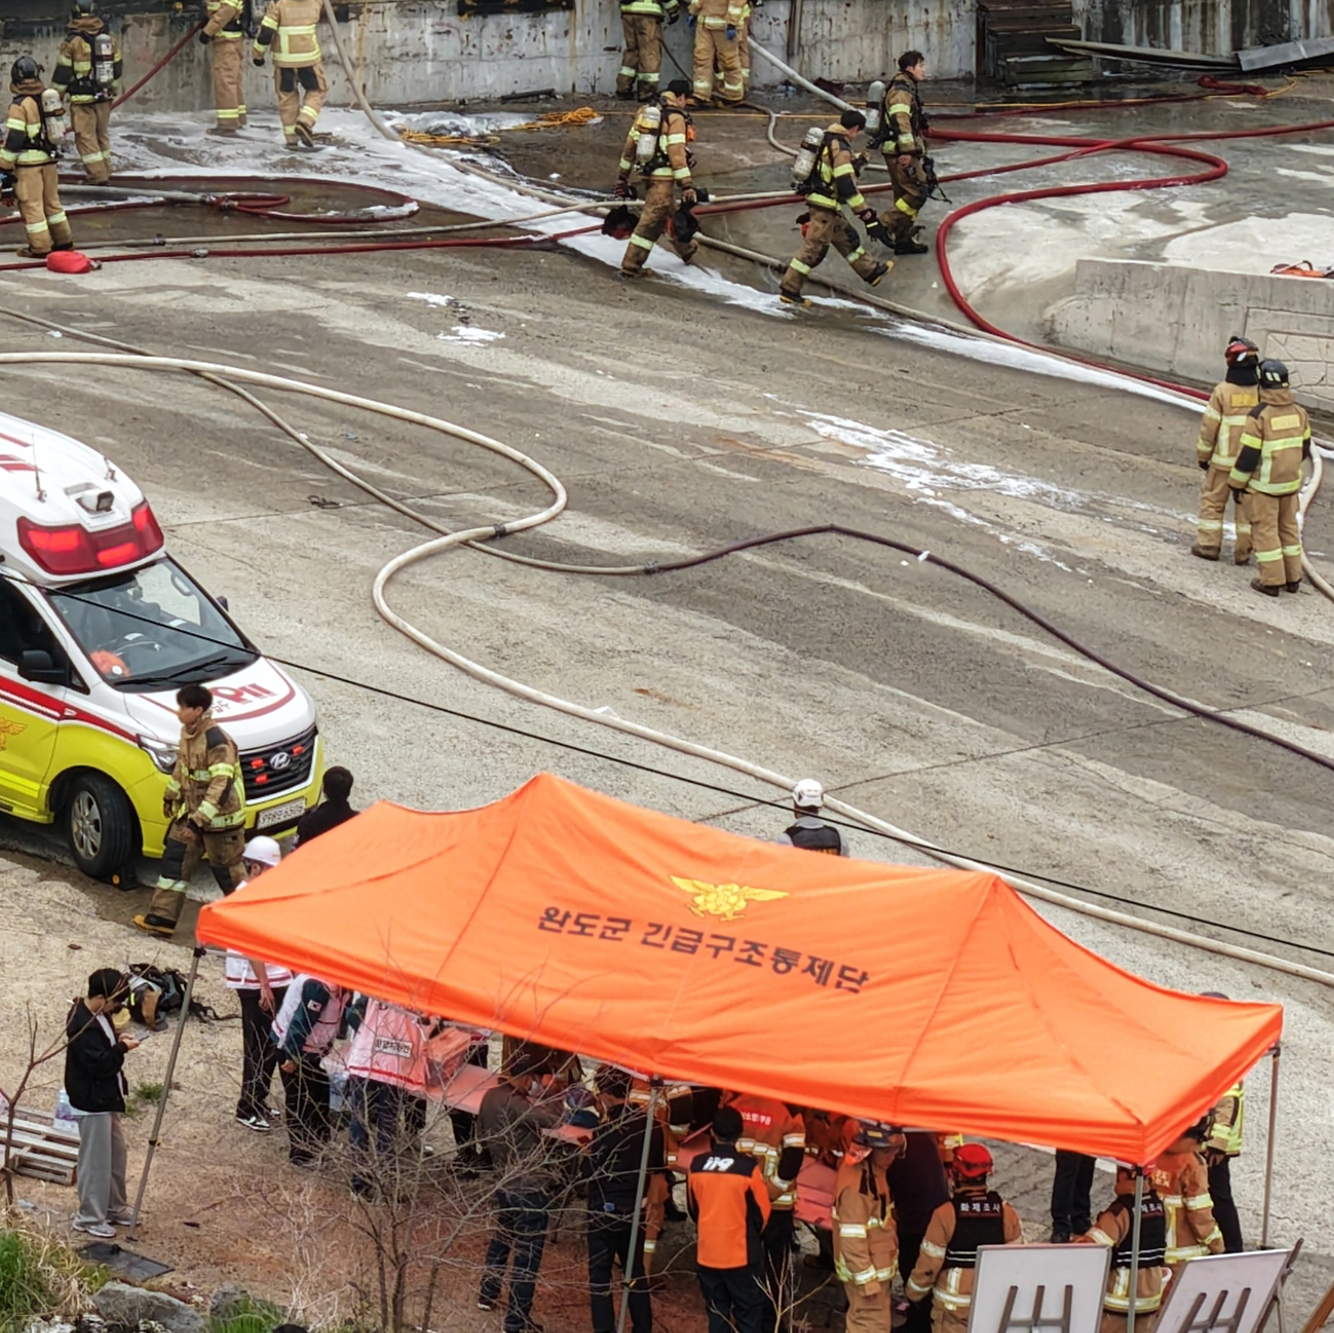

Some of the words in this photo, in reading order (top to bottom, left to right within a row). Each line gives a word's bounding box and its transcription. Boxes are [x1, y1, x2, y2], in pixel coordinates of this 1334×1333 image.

[209, 683, 278, 705] 119
[537, 906, 632, 942] 완도군
[640, 922, 870, 994] 긴급구조통제단
[702, 1156, 735, 1172] 119
